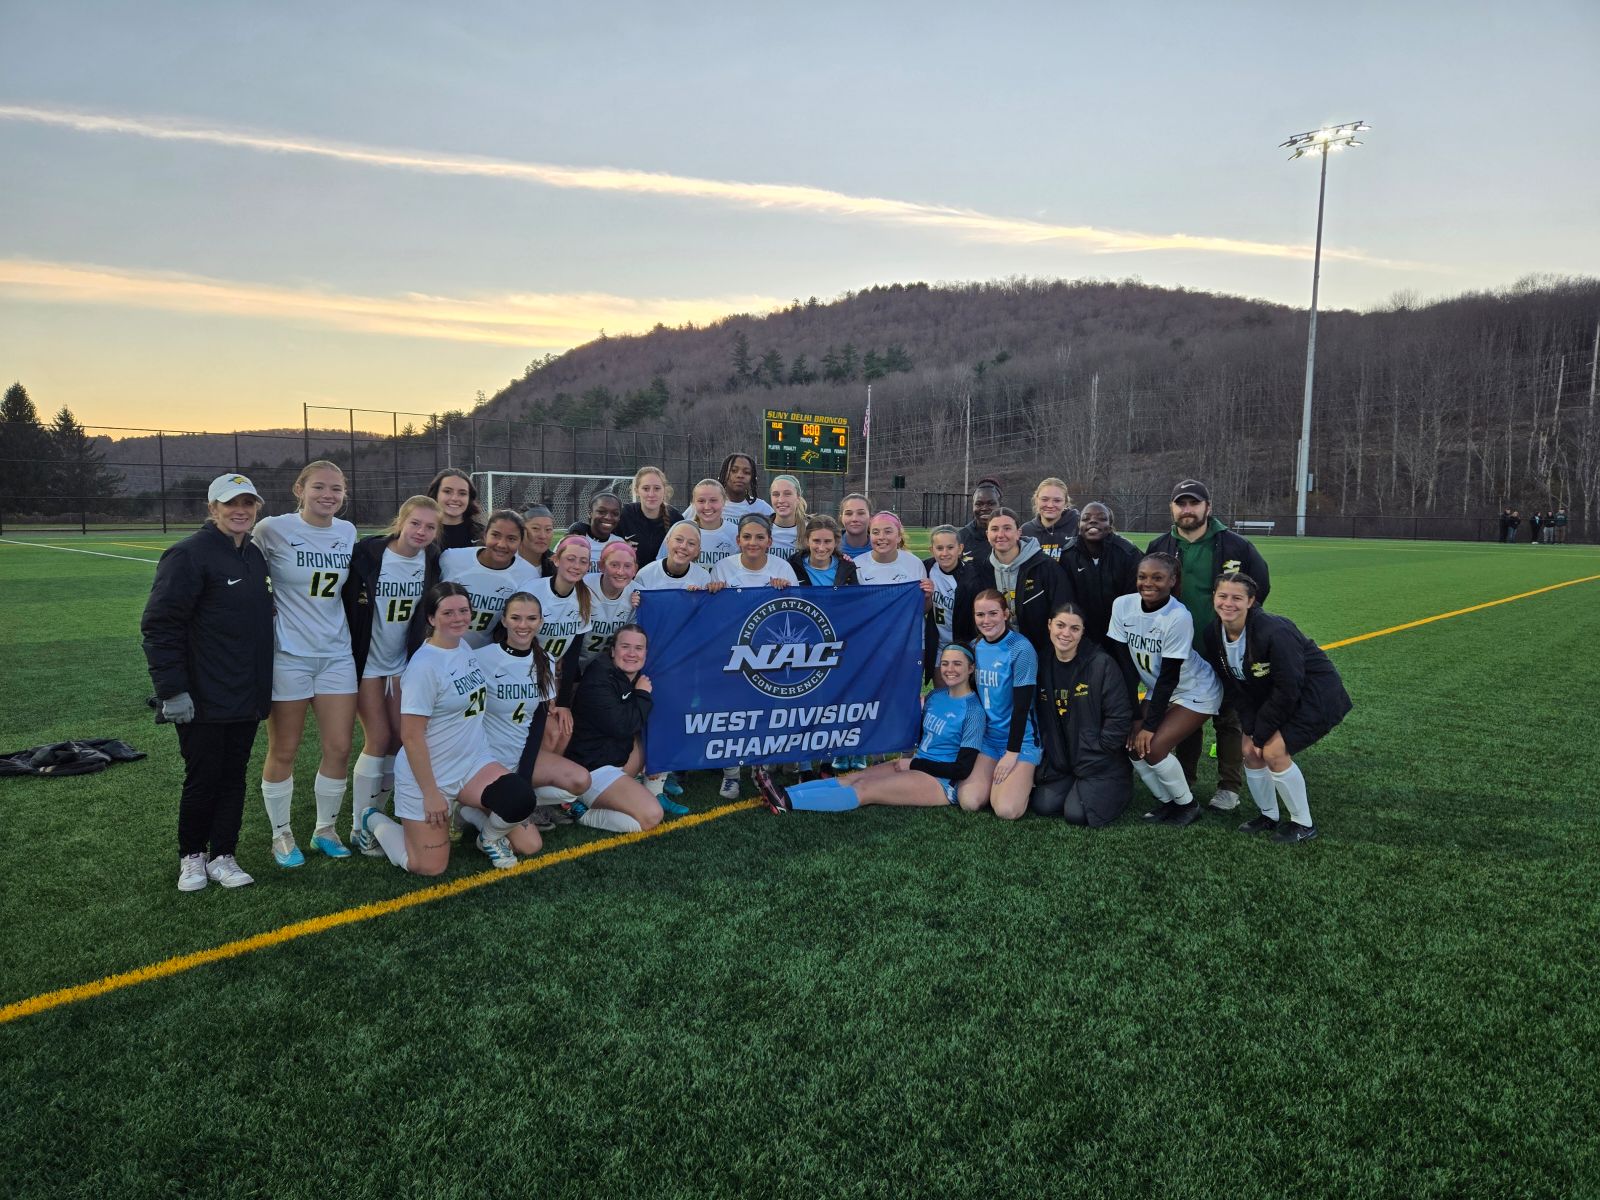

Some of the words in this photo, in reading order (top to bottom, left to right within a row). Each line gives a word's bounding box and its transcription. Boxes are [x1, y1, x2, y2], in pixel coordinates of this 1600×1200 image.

[767, 411, 788, 419] SUNY
[791, 413, 812, 421] DELHI
[814, 415, 848, 425] BRONCOS
[803, 424, 820, 436] 0:00
[839, 435, 845, 446] 0
[310, 571, 339, 598] 12
[387, 599, 413, 622] 15
[743, 604, 776, 640] NORTH
[781, 601, 831, 636] ATLANTIC
[544, 638, 566, 657] 10
[723, 641, 843, 671] NAC
[752, 671, 824, 695] CONFERENCE
[512, 702, 525, 723] 4
[685, 710, 763, 735] WEST
[768, 701, 880, 730] DIVISION
[923, 712, 947, 736] DELHI
[705, 728, 861, 760] CHAMPIONS
